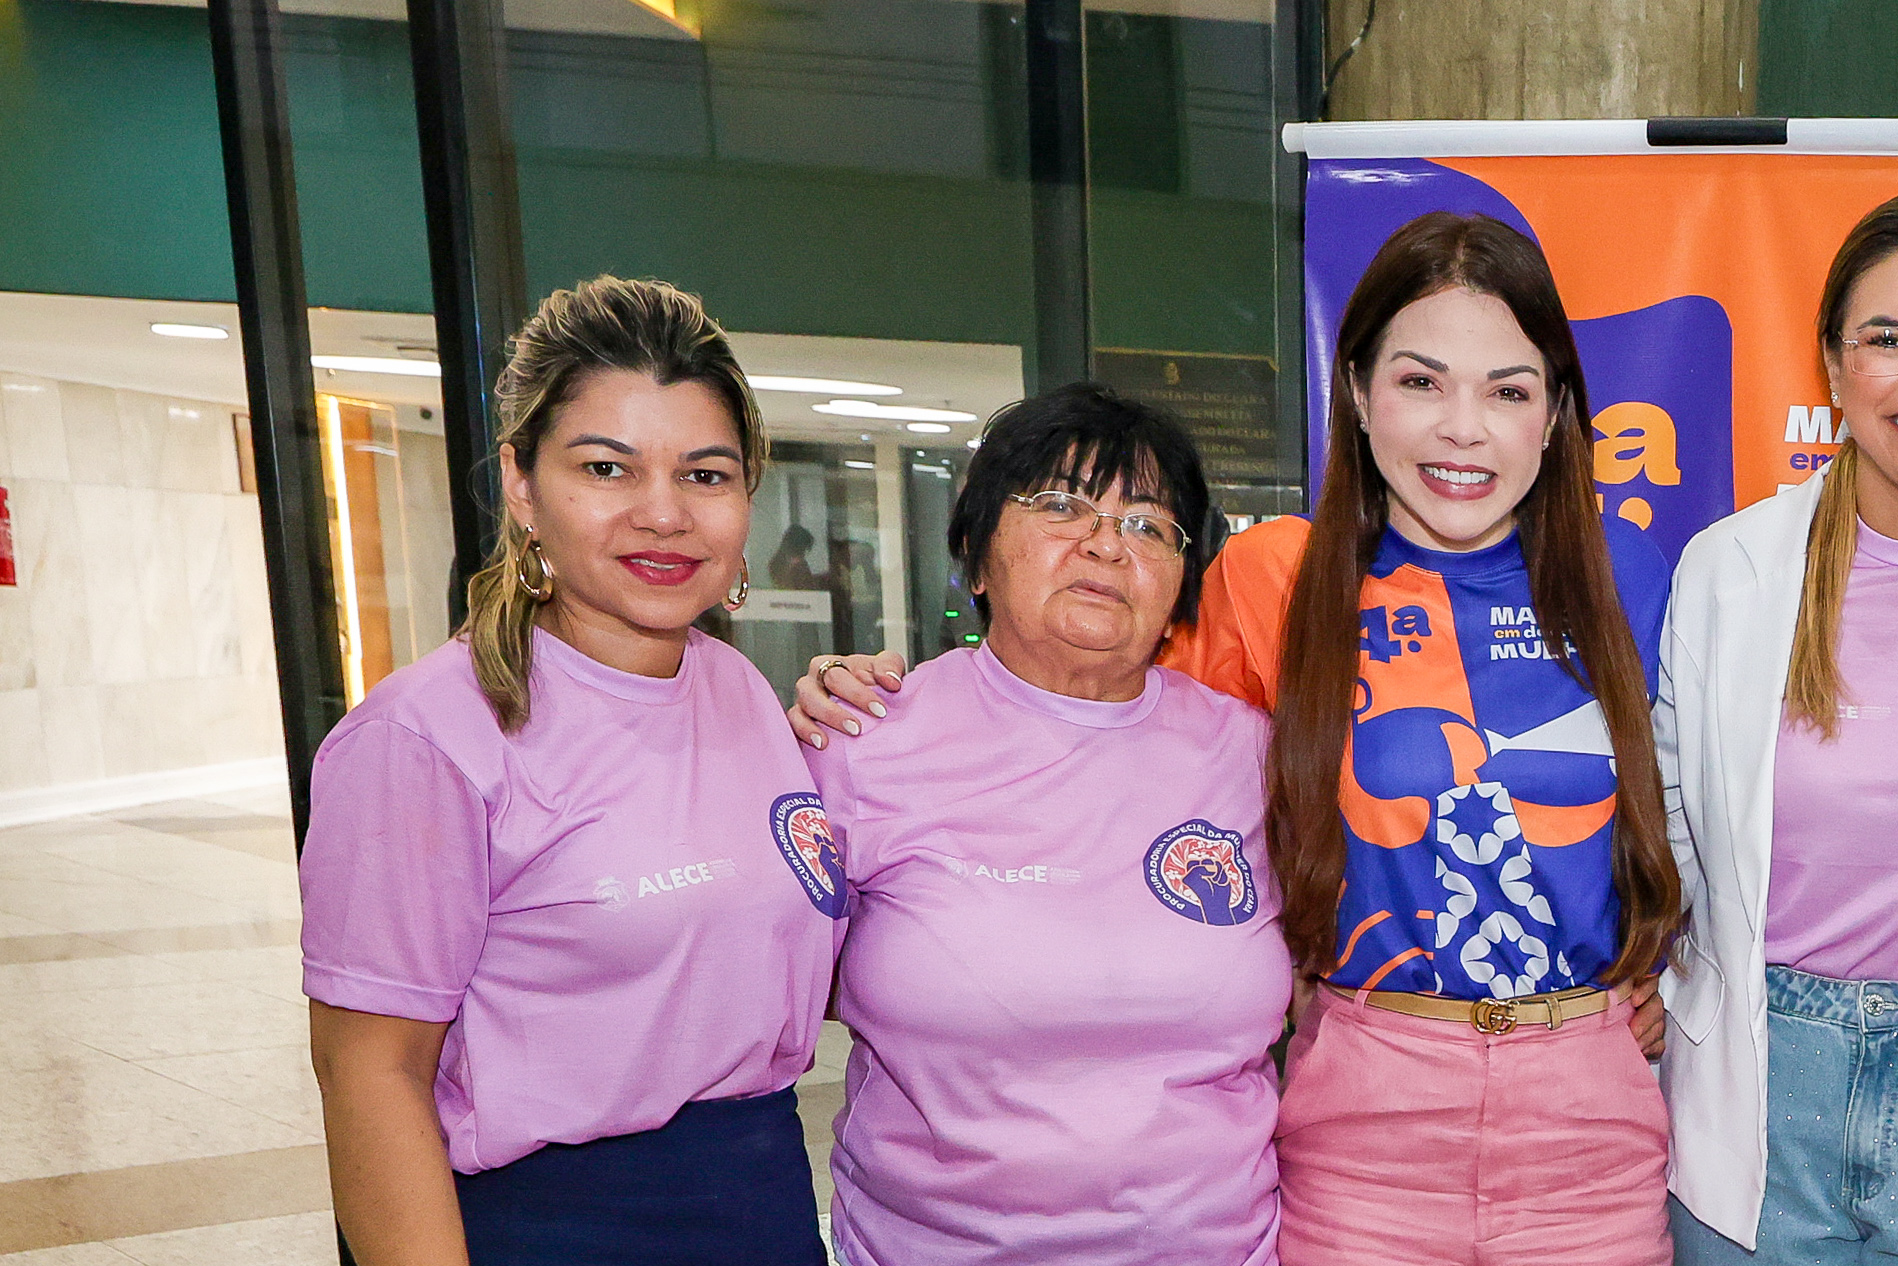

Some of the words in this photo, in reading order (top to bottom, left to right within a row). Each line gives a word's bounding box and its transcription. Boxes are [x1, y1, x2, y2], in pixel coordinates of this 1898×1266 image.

[776, 797, 808, 820] ESPECIAL
[1164, 824, 1206, 842] ESPECIAL
[1207, 830, 1223, 838] DA
[775, 820, 823, 901] PROCURADORIA
[637, 861, 714, 898] ALECE
[974, 863, 1048, 883] ALECE
[1149, 842, 1186, 910] PROCURADORIA
